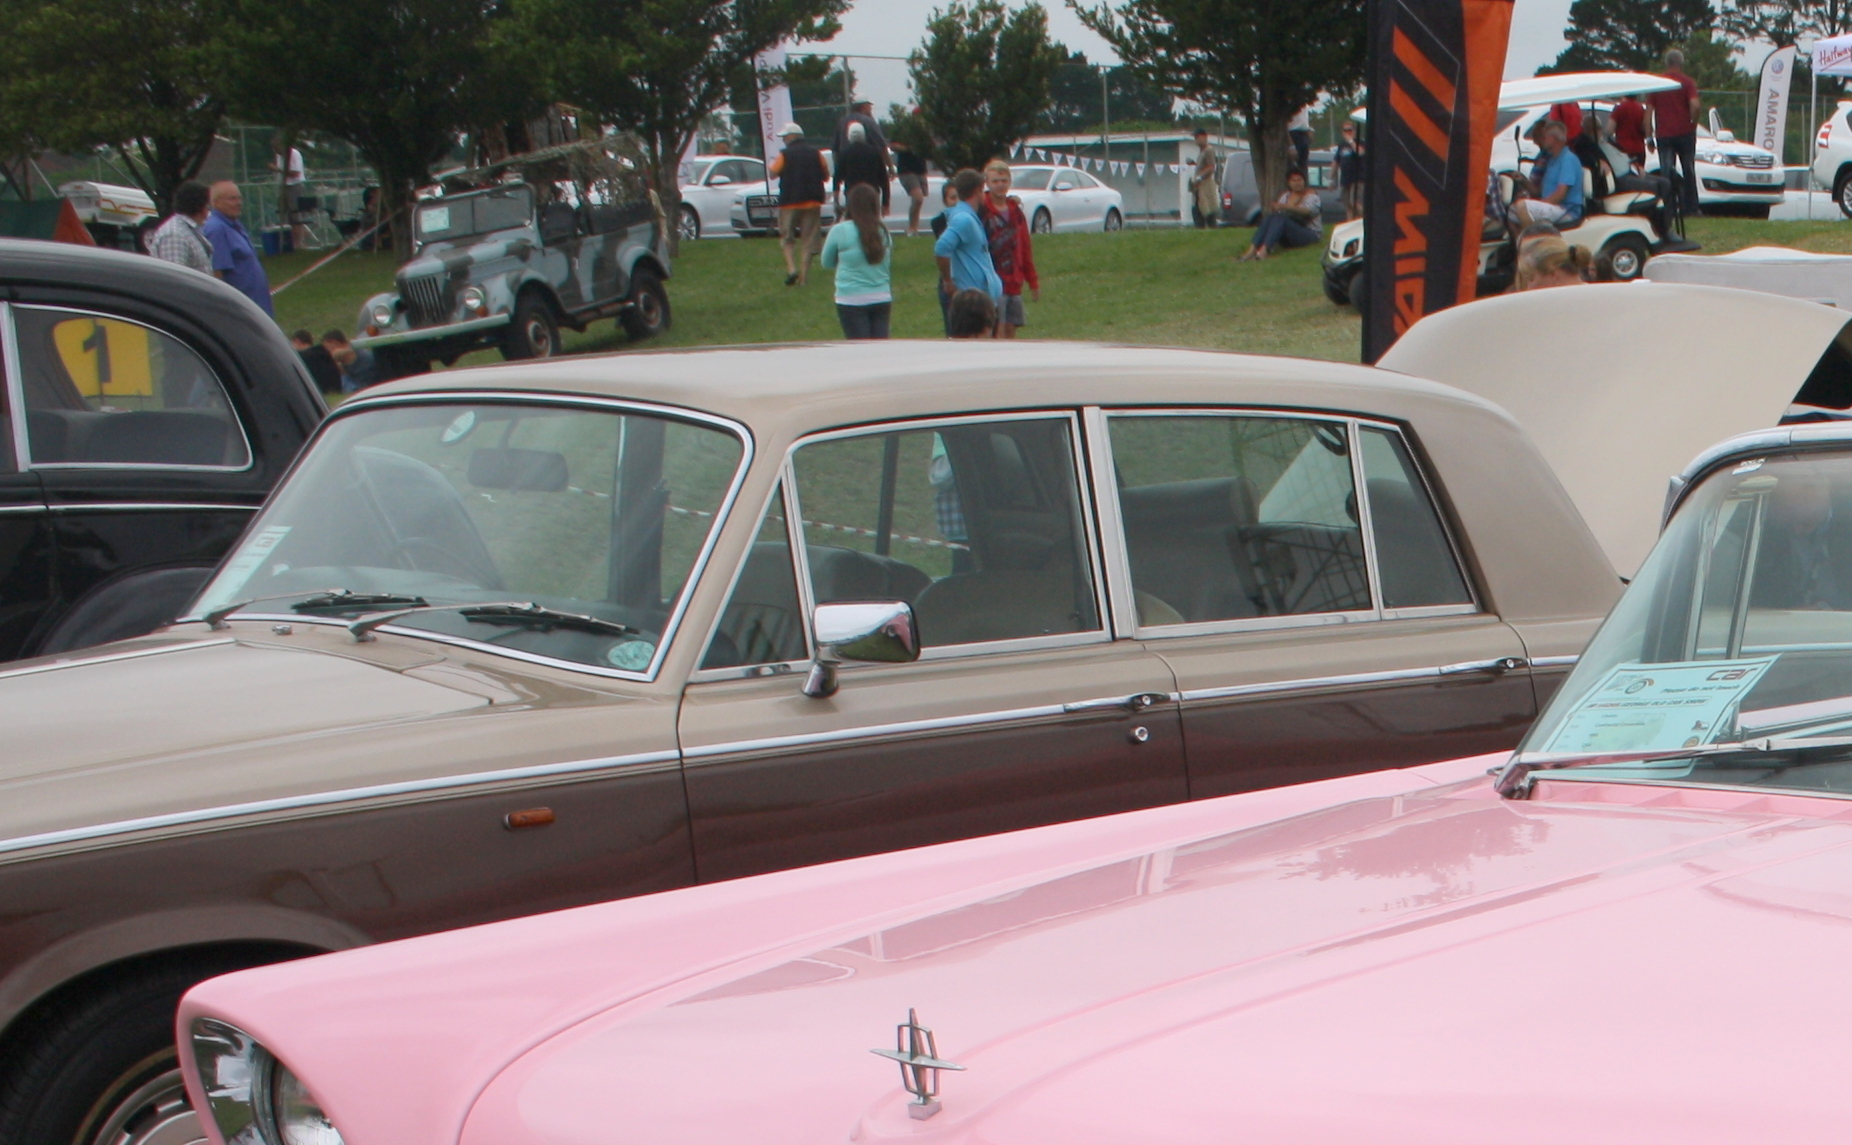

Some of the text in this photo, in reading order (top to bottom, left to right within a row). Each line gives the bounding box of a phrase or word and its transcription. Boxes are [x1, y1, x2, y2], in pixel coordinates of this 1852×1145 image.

[763, 107, 775, 143] Audi
[1763, 88, 1780, 150] AMARO
[1706, 668, 1757, 681] car
